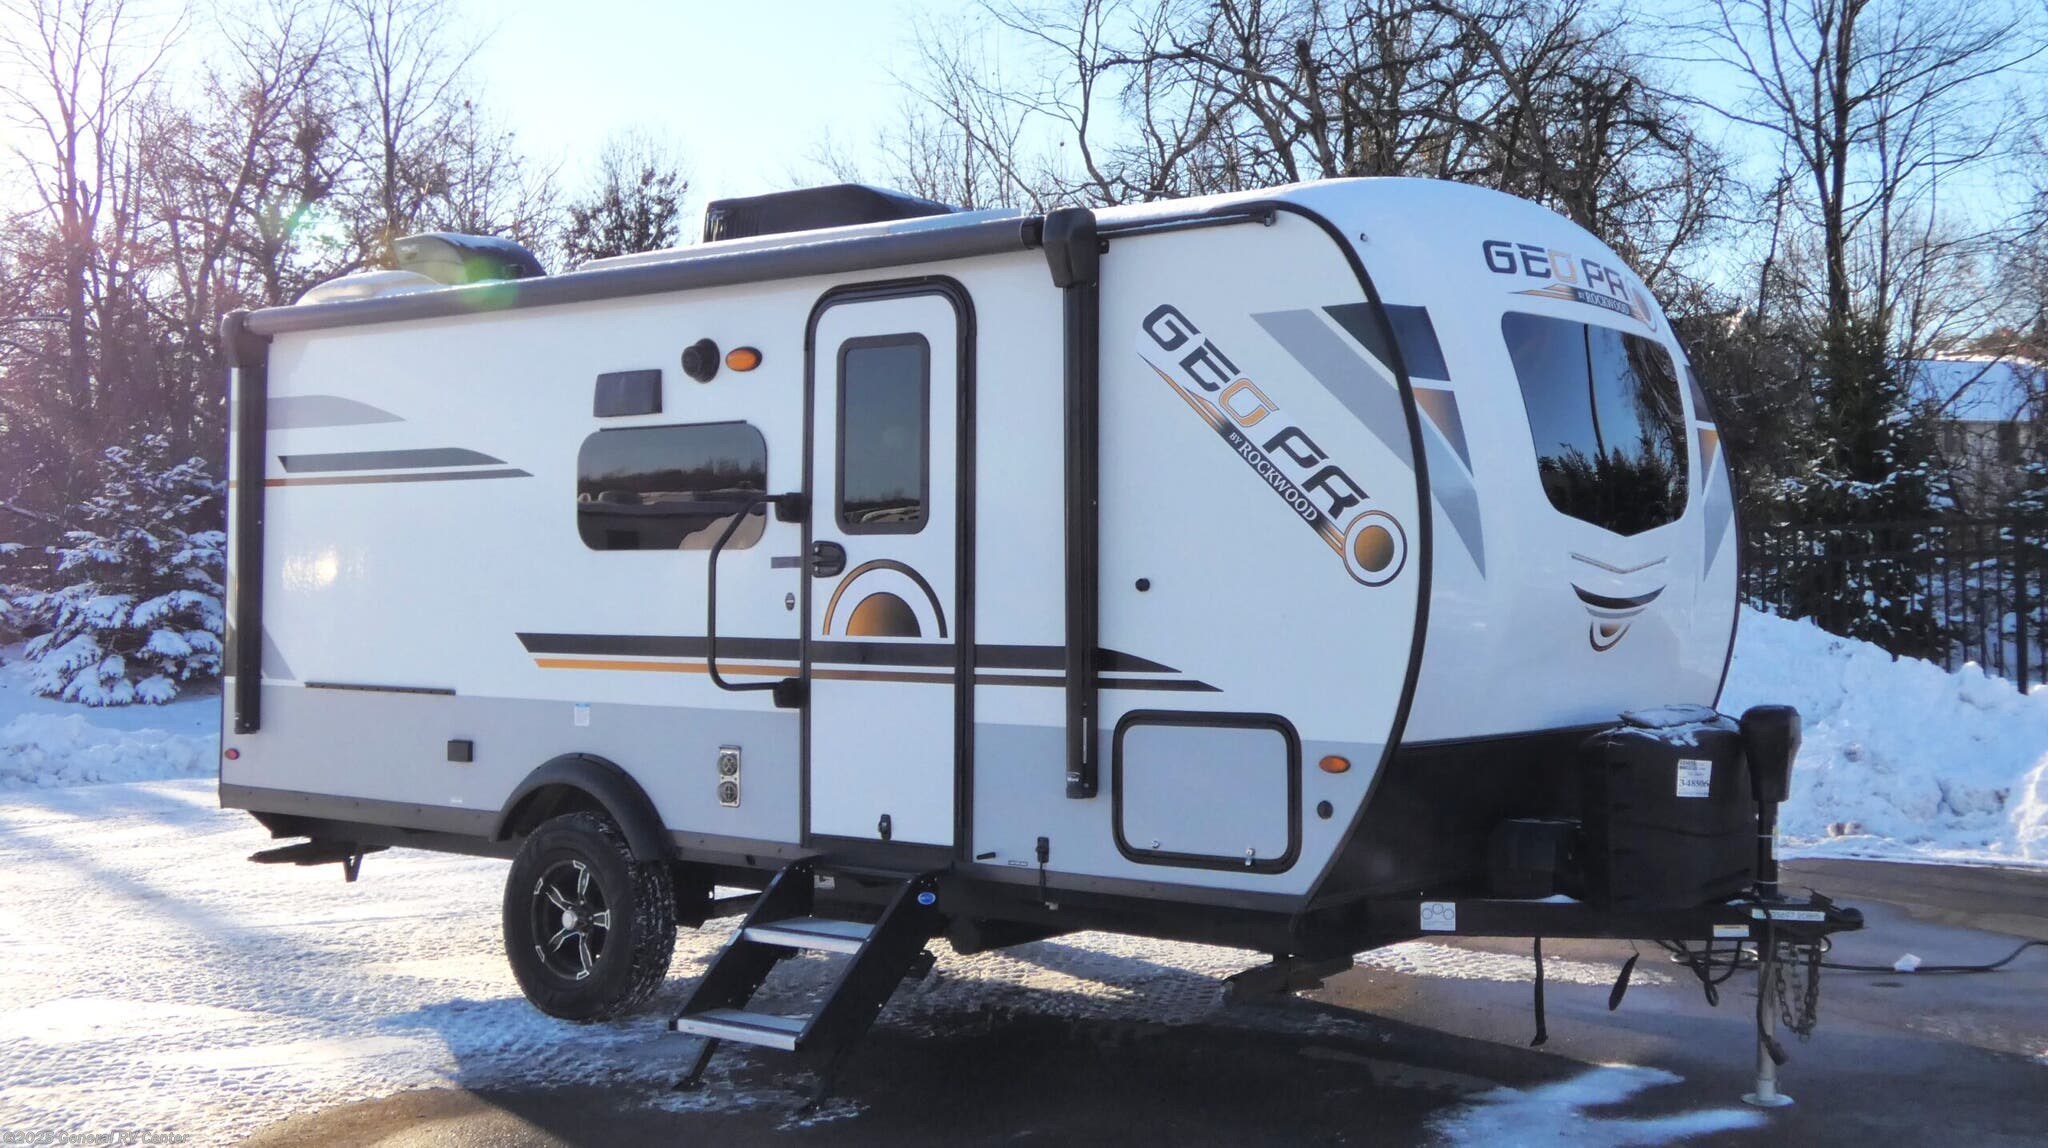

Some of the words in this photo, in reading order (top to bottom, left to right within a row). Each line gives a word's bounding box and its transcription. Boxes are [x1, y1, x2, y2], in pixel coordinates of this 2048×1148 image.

[1482, 240, 1577, 283] GEO
[1585, 291, 1630, 314] ROCKWOOD
[1142, 303, 1279, 428] GEO
[1228, 432, 1242, 445] BY
[1239, 441, 1318, 521] ROCKWOOD
